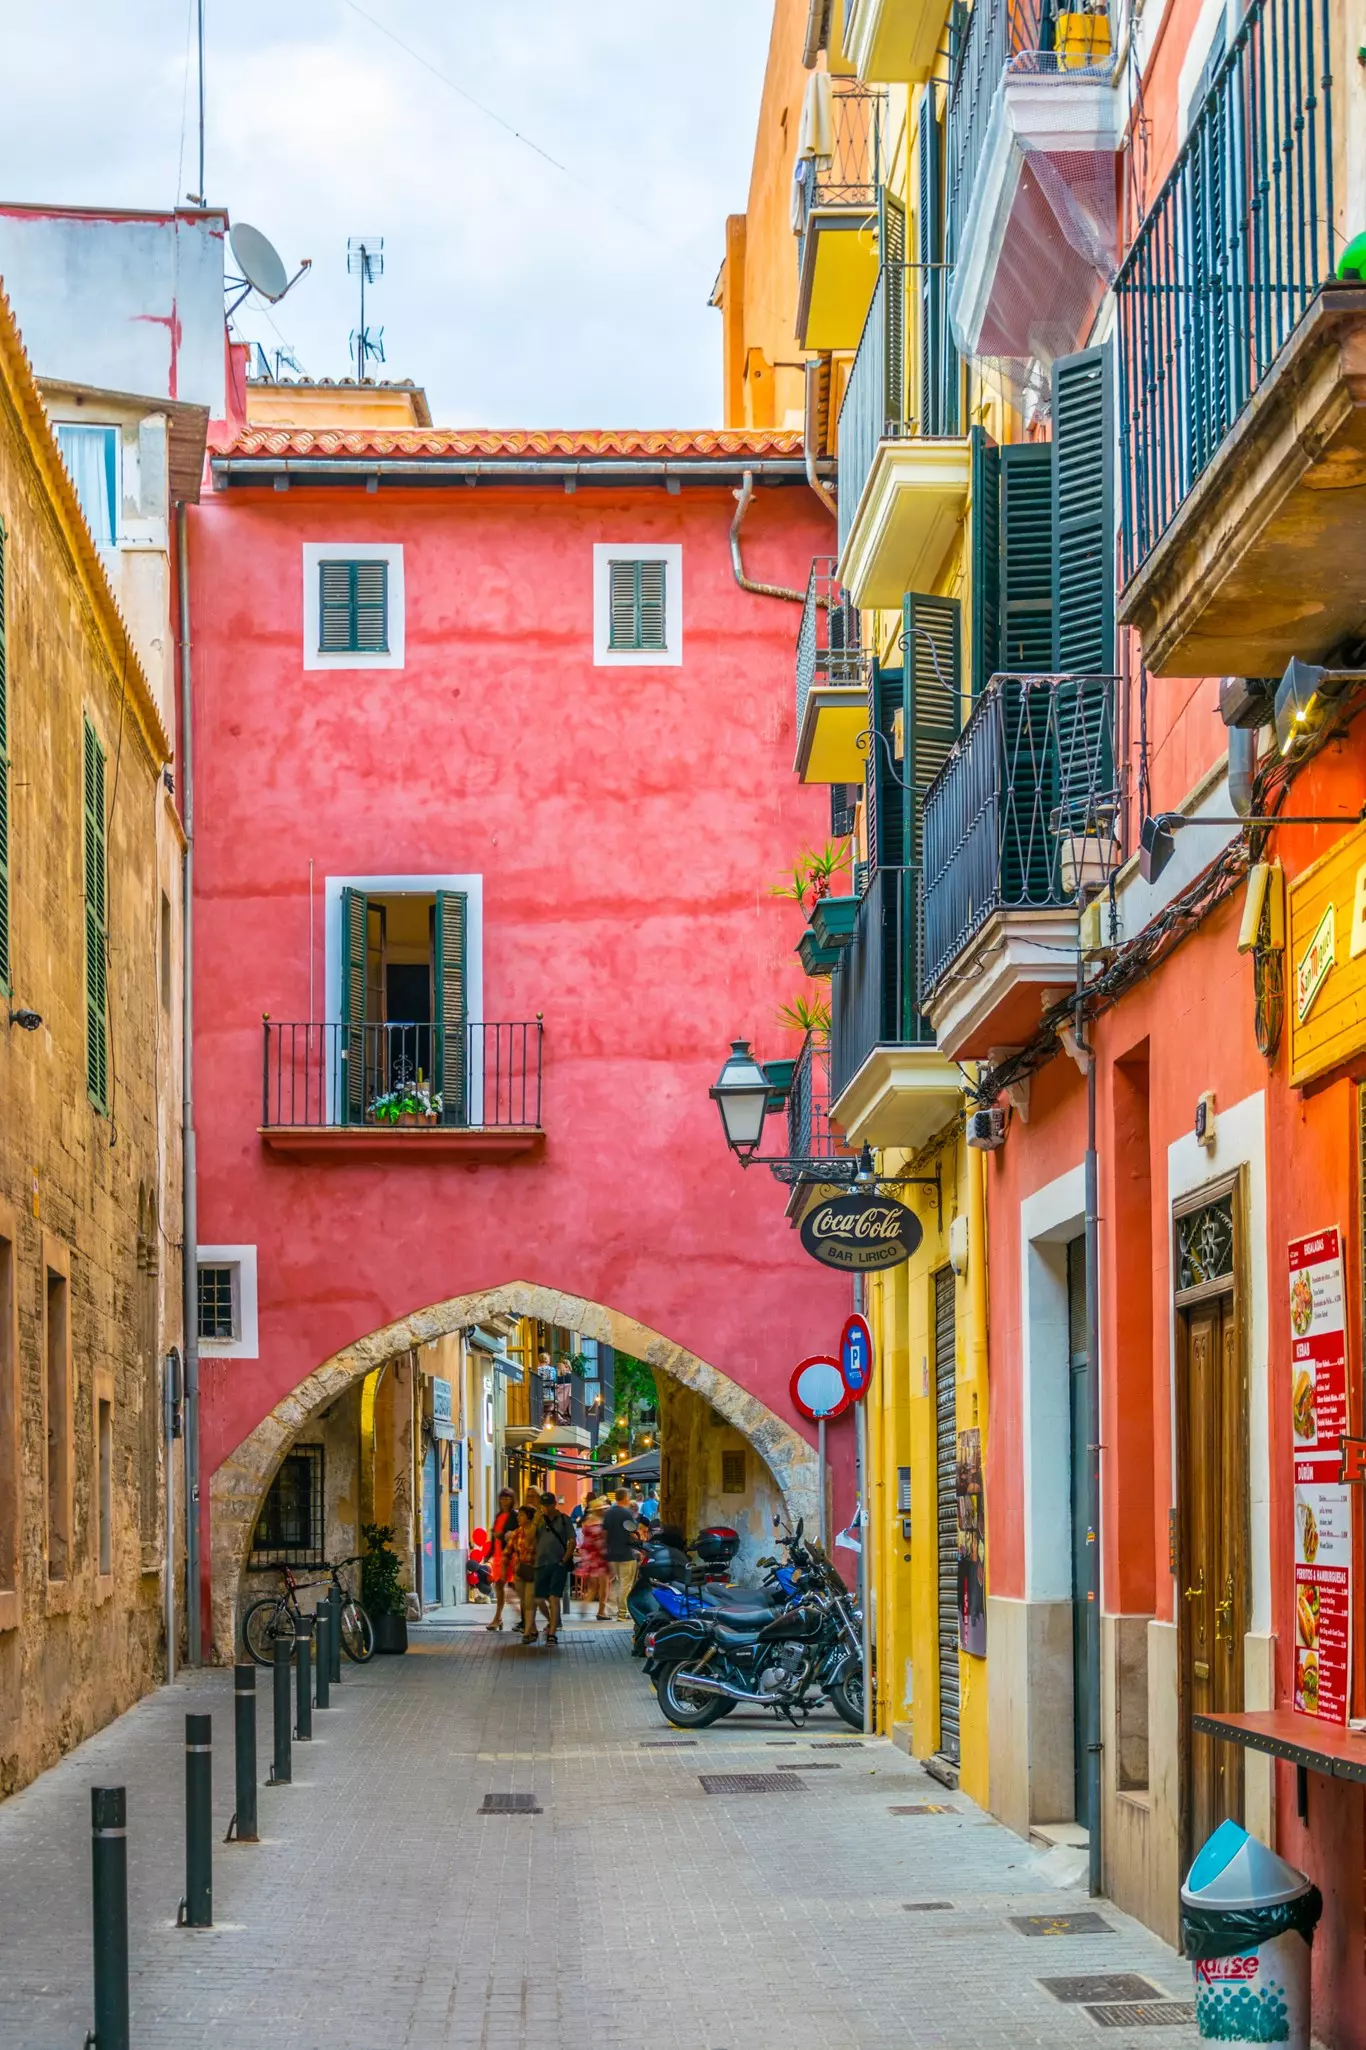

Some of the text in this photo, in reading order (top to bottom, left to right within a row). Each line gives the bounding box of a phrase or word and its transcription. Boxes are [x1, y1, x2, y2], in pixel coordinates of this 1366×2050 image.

[812, 1207, 904, 1239] Coca-Cola
[827, 1246, 897, 1263] BAR LIRICO
